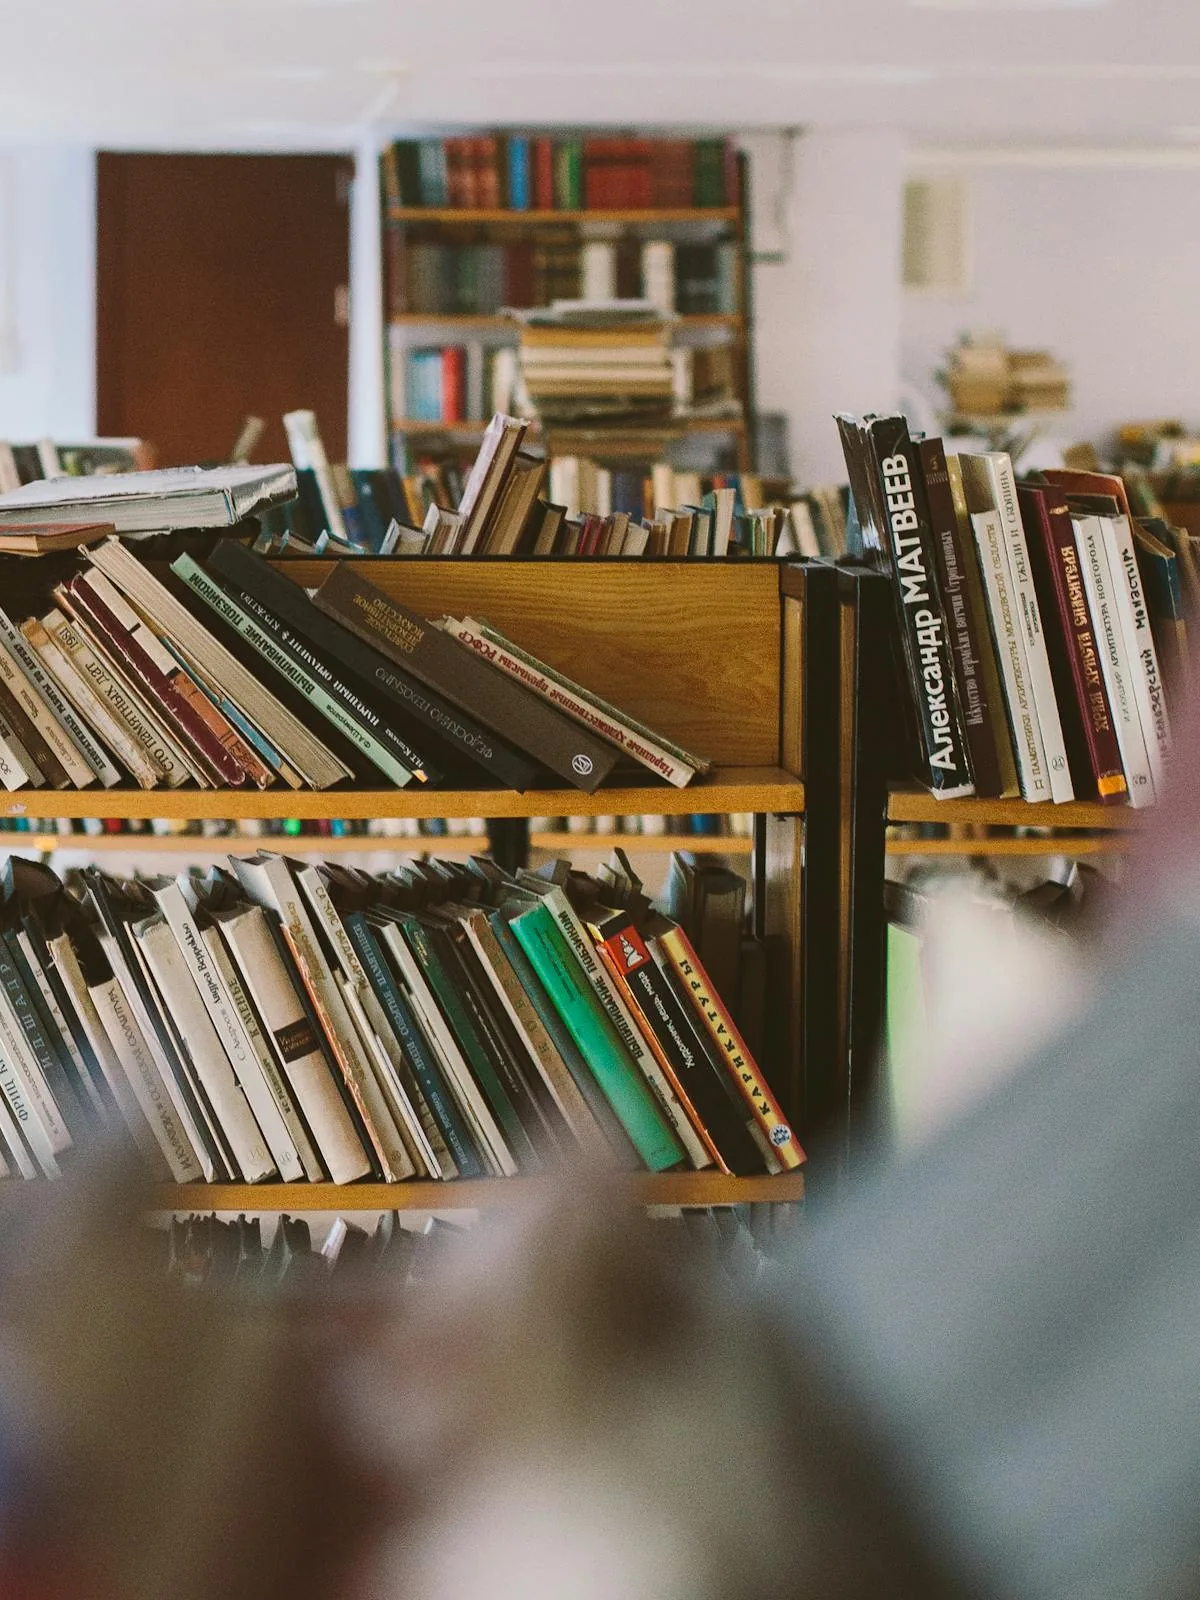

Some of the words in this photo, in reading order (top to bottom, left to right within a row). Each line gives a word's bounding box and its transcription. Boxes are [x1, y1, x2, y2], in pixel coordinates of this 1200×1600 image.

[998, 470, 1017, 523] СКОПИНА
[880, 452, 929, 604] МАТВЕЕВ
[985, 524, 1001, 568] ОБЛАСТИ
[1009, 529, 1019, 537] И
[937, 530, 961, 592] Строгановых
[1011, 543, 1028, 582] ГЖЕЛИ
[1059, 545, 1087, 626] СПАСИТЕЛЯ
[1085, 534, 1106, 599] НОВГОРОДА
[1119, 546, 1146, 629] Монастырь
[58, 626, 79, 649] 1981
[352, 593, 419, 646] ДЕКОРАТИВНОЕ
[363, 613, 414, 654] СОВЕТСКОЕ
[372, 597, 425, 639] ИСКУССТВО
[1099, 602, 1120, 667] АРХИТЕКТУРА
[12, 641, 37, 671] ДЕРЕВУ
[242, 624, 315, 694] ВЫПИЛИВАНИЕ
[287, 636, 334, 681] ОРНАМЕНТ
[456, 629, 497, 660] РСФСР
[1076, 631, 1100, 686] ХРИСТА
[32, 669, 45, 683] ПО
[42, 683, 66, 714] РАБОТЫ
[373, 665, 431, 712] FEDOSKINO
[496, 654, 549, 693] промыслы
[906, 608, 957, 774] Александр
[1007, 640, 1028, 710] АРХИТЕКТУРЫ
[331, 679, 380, 726] НАРОДНЫЙ
[548, 687, 627, 744] художественные
[1087, 690, 1109, 732] ХРАМ
[62, 712, 107, 770] ДЕКОРАТИВНЫЕ
[383, 727, 412, 756] Климова
[428, 706, 495, 760] ФЕДОСКИНО
[625, 738, 675, 777] Народные
[1021, 713, 1040, 775] ПАМЯТНИКИ
[178, 921, 208, 971] Верроккьо
[351, 923, 387, 987] ПАМЯТНИКИ
[201, 971, 223, 1005] Андреа
[226, 976, 260, 1038] К.МЕНЬЕ
[636, 970, 655, 996] мода
[650, 993, 670, 1022] вещь,
[105, 987, 137, 1047] СКУЛЬПТУРА
[592, 975, 644, 1059] ВЫПИЛИВАНИЕ
[678, 958, 771, 1115] КАРИКАТУРЫ
[663, 1018, 696, 1069] Художник,
[2, 1079, 31, 1123] ФРИЦ
